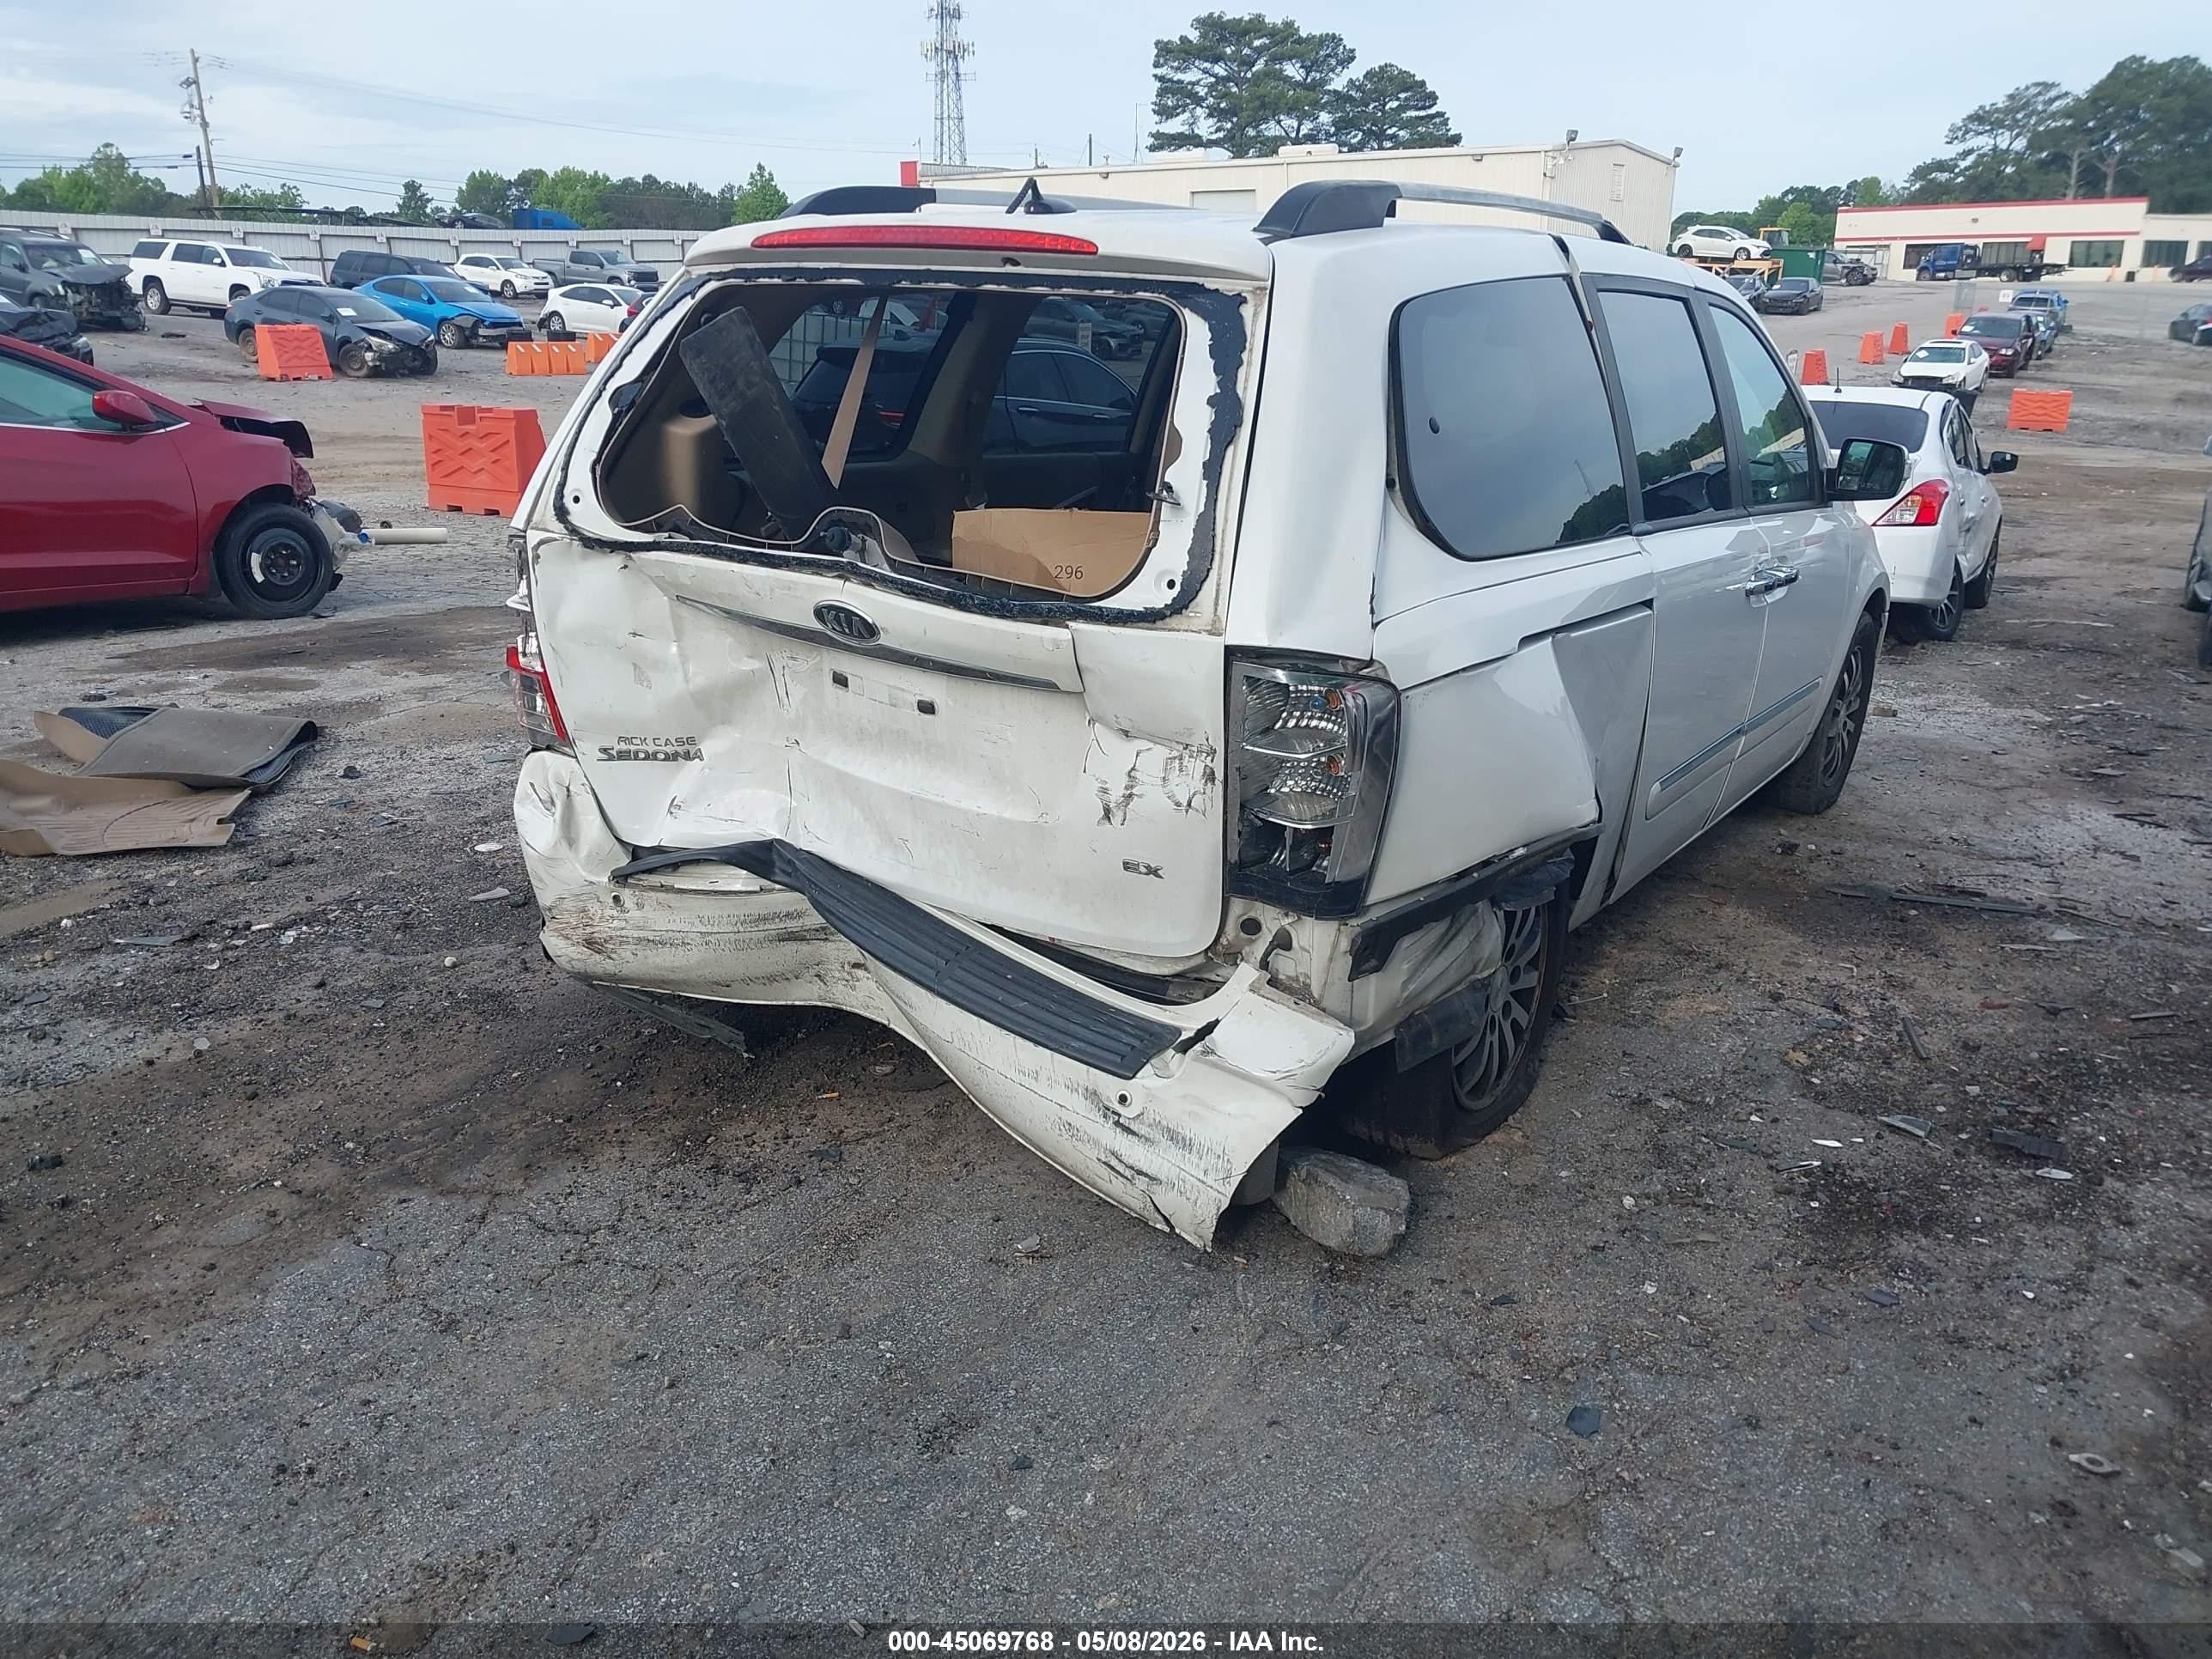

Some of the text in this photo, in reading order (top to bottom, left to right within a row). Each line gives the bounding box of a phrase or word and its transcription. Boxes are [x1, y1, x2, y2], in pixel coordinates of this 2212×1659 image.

[1054, 564, 1084, 580] 296
[821, 607, 871, 639] KIA
[617, 736, 697, 747] RICK CASE
[596, 745, 705, 763] SEDONA
[1121, 858, 1165, 879] EX
